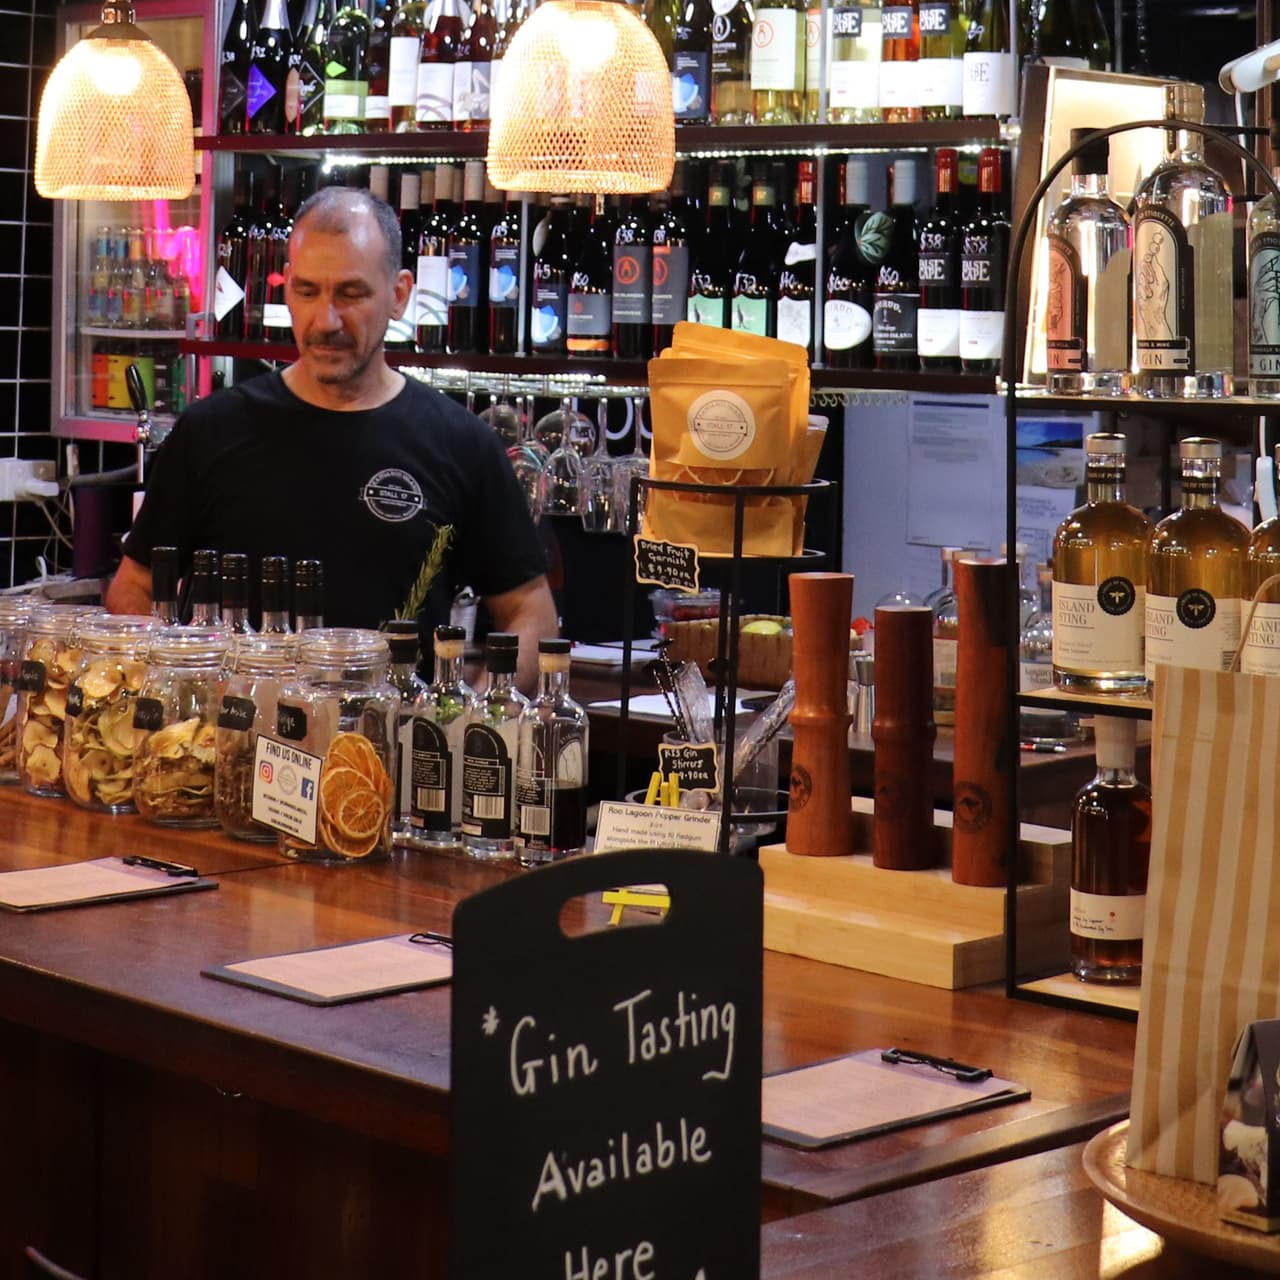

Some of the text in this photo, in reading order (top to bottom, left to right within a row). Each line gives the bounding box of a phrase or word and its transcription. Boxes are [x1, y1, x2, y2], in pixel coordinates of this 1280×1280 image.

[666, 545, 690, 560] Fruit
[1058, 599, 1095, 615] ISLAND
[1058, 612, 1087, 626] STING
[265, 741, 312, 771] FIND US ONLINE
[683, 748, 698, 760] Gin
[608, 806, 624, 816] Roo
[625, 808, 654, 819] Lagoon
[683, 814, 713, 825] Grinder
[508, 988, 736, 1098] Gin Tasting
[531, 1118, 713, 1212] Available
[564, 1240, 656, 1280] Here
